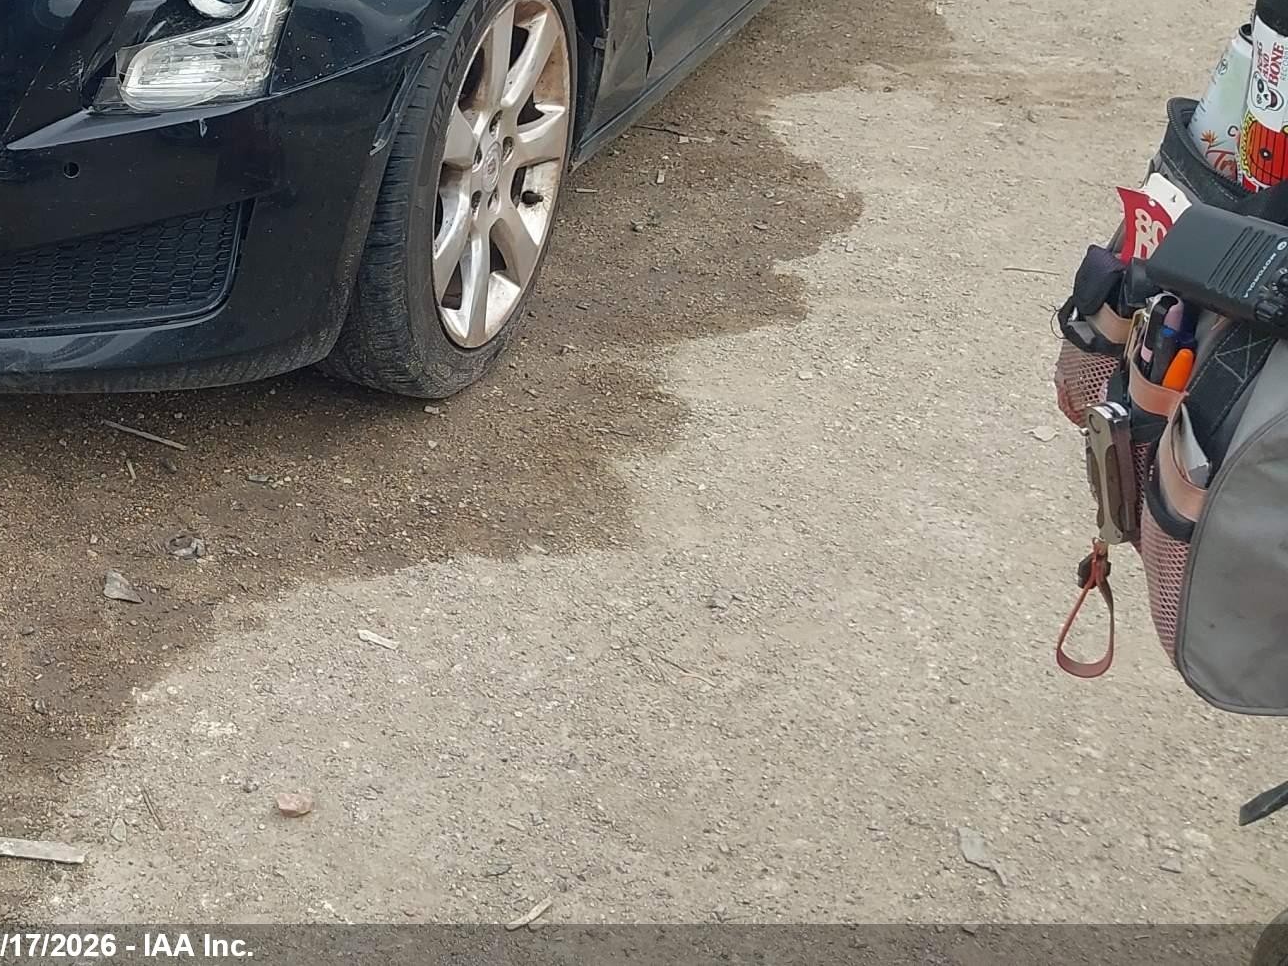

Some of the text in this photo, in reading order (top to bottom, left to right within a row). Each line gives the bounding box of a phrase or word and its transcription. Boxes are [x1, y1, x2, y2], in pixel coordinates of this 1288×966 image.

[431, 38, 467, 132] MACH
[1268, 41, 1285, 87] BONE
[1244, 252, 1276, 298] MOTOROLA
